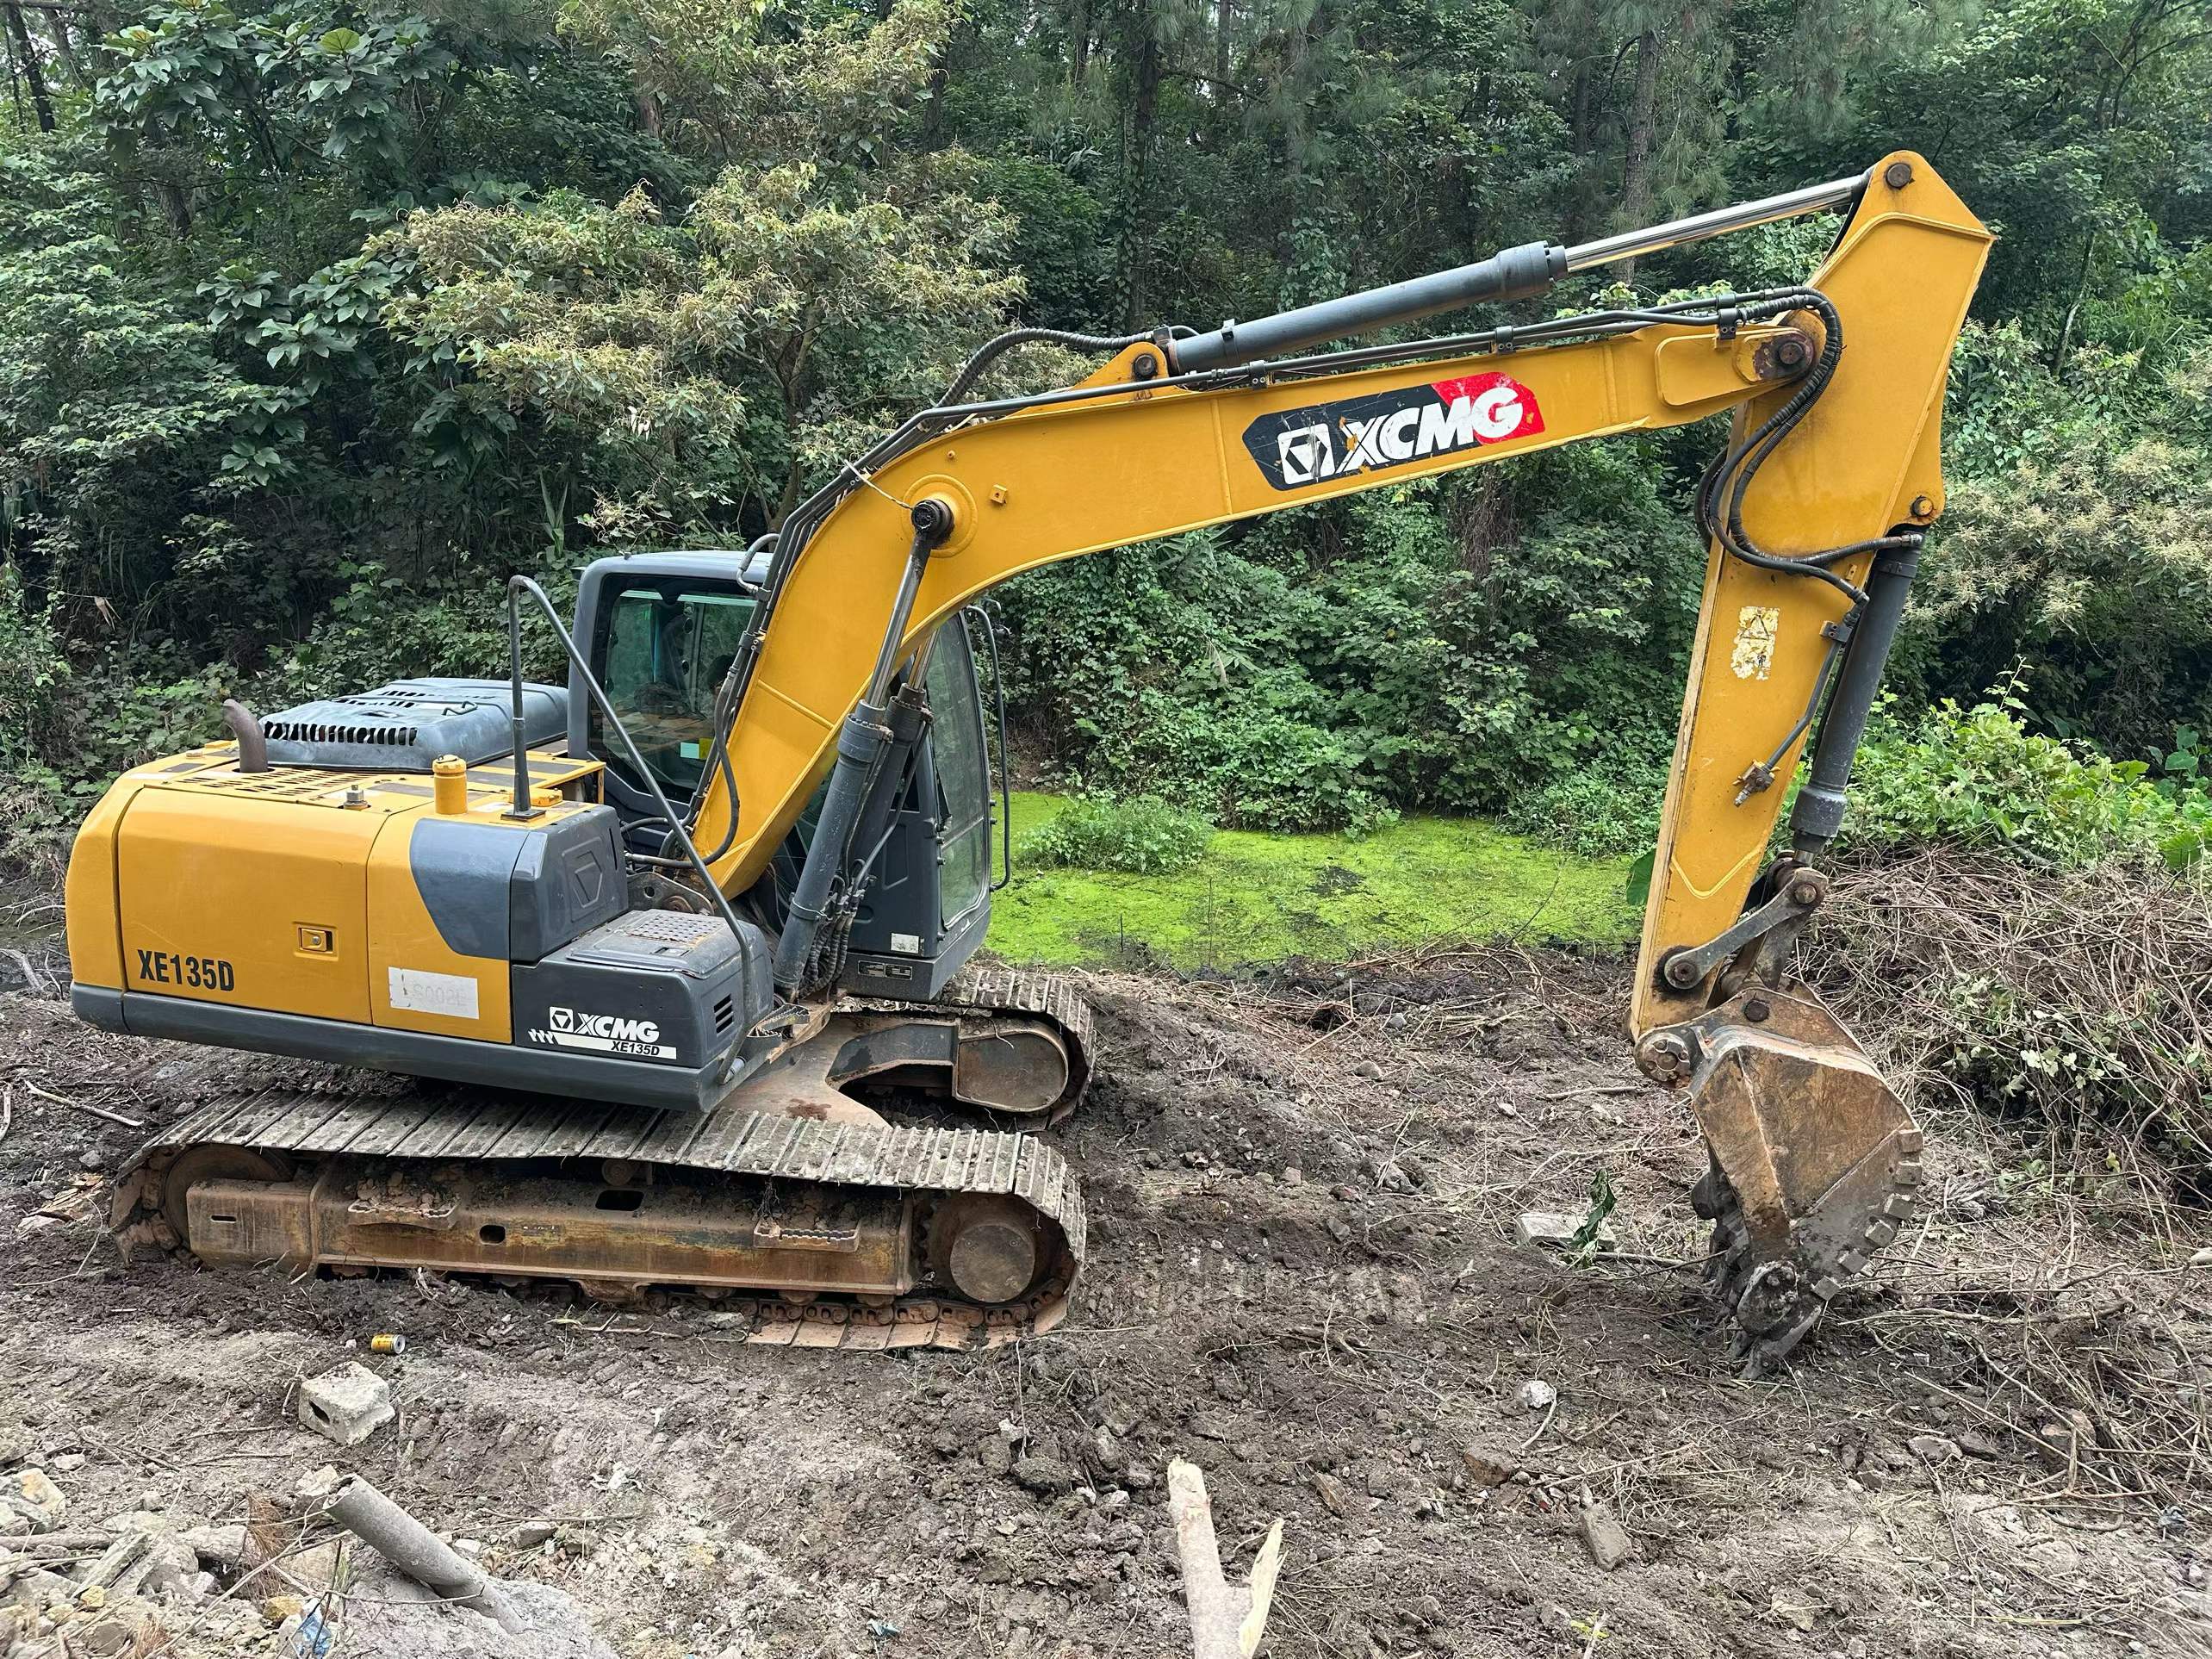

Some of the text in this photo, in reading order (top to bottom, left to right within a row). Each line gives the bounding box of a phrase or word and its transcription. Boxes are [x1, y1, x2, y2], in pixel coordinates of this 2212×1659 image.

[1336, 388, 1523, 474] XCMG
[138, 949, 234, 991] XE135D
[575, 1013, 660, 1043] XCMG
[611, 1041, 660, 1056] XE135D
